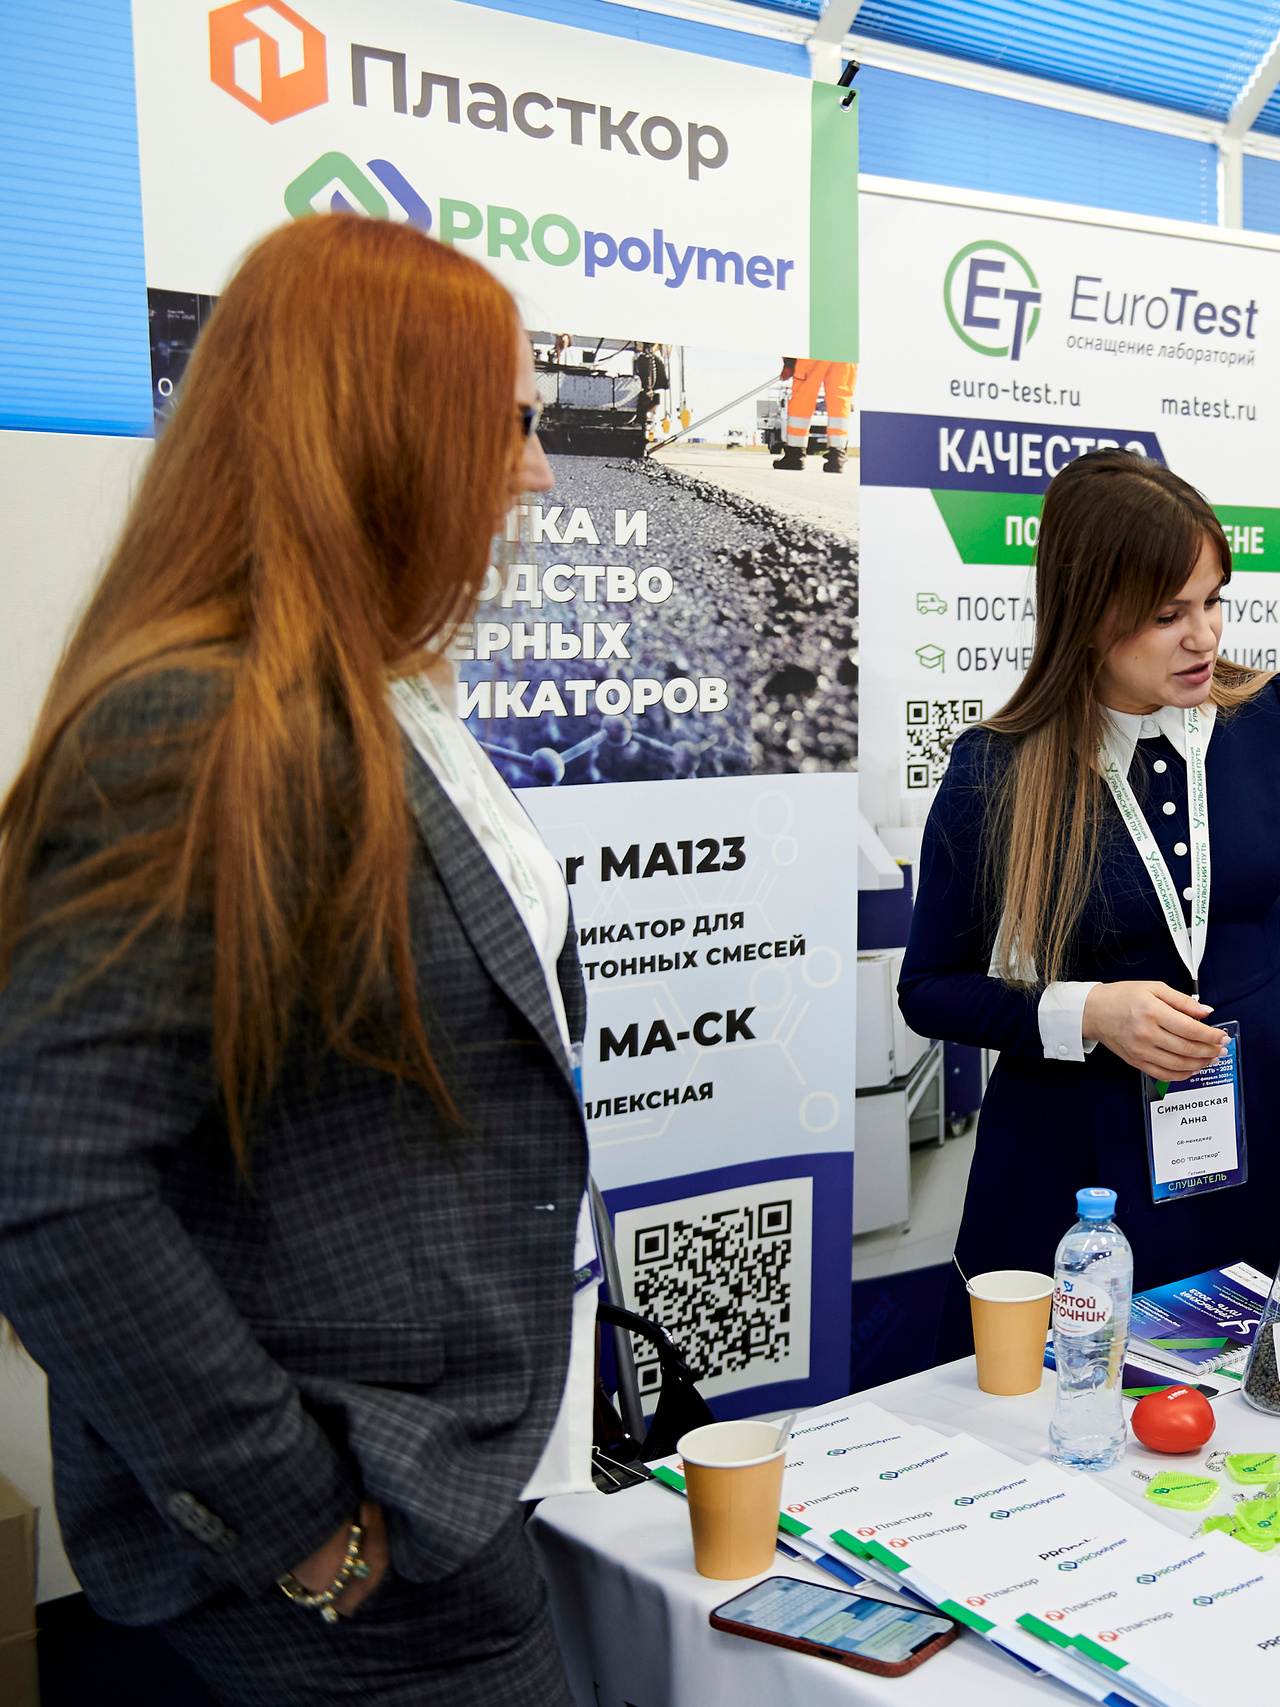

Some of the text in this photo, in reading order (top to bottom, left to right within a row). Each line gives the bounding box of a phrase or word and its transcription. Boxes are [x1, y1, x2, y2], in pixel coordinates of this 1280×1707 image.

[350, 43, 729, 181] Пласткор
[439, 197, 794, 291] PROpolymer
[963, 258, 1042, 362] ET
[1070, 275, 1259, 340] EuroTest
[1066, 333, 1256, 368] оснащение лабораторий
[950, 376, 1081, 407] euro-test.ru
[1161, 395, 1257, 422] matest.ru
[615, 508, 648, 546] И
[1109, 775, 1142, 842] УРАЛЬСКИЙ ПУТЬ
[601, 836, 746, 882] MA123
[1149, 864, 1178, 933] УРАЛЬСКИЙ ПУТЬ
[692, 911, 744, 937] ДЛЯ
[580, 934, 806, 980] ТОННЫХ СМЕСЕЙ
[599, 1006, 757, 1062] МА-СК
[1157, 1096, 1229, 1115] Симановская
[1180, 1115, 1208, 1126] Анна
[1168, 1174, 1227, 1191] СЛУШАТЕЛЬ
[1179, 1290, 1234, 1319] УРАЛЬСКИЙ
[1218, 1302, 1242, 1317] ПУТЬ
[795, 1416, 850, 1437] PROpolymer
[846, 1434, 901, 1453] PROpolymer
[897, 1451, 949, 1475] PROpolymer
[804, 1484, 860, 1508] Пласткор
[972, 1478, 1028, 1501] PROpolymer
[1010, 1492, 1066, 1515] PROpolymer
[874, 1510, 933, 1532] Пласткор
[907, 1522, 968, 1543] Пласткор
[1076, 1537, 1128, 1565] PROpolymer
[1154, 1550, 1206, 1578] PROpolymer
[983, 1576, 1039, 1601] Пласткор
[1211, 1574, 1265, 1601] PROpolymer
[1062, 1590, 1118, 1614] Пласткор
[1115, 1610, 1174, 1635] Пласткор
